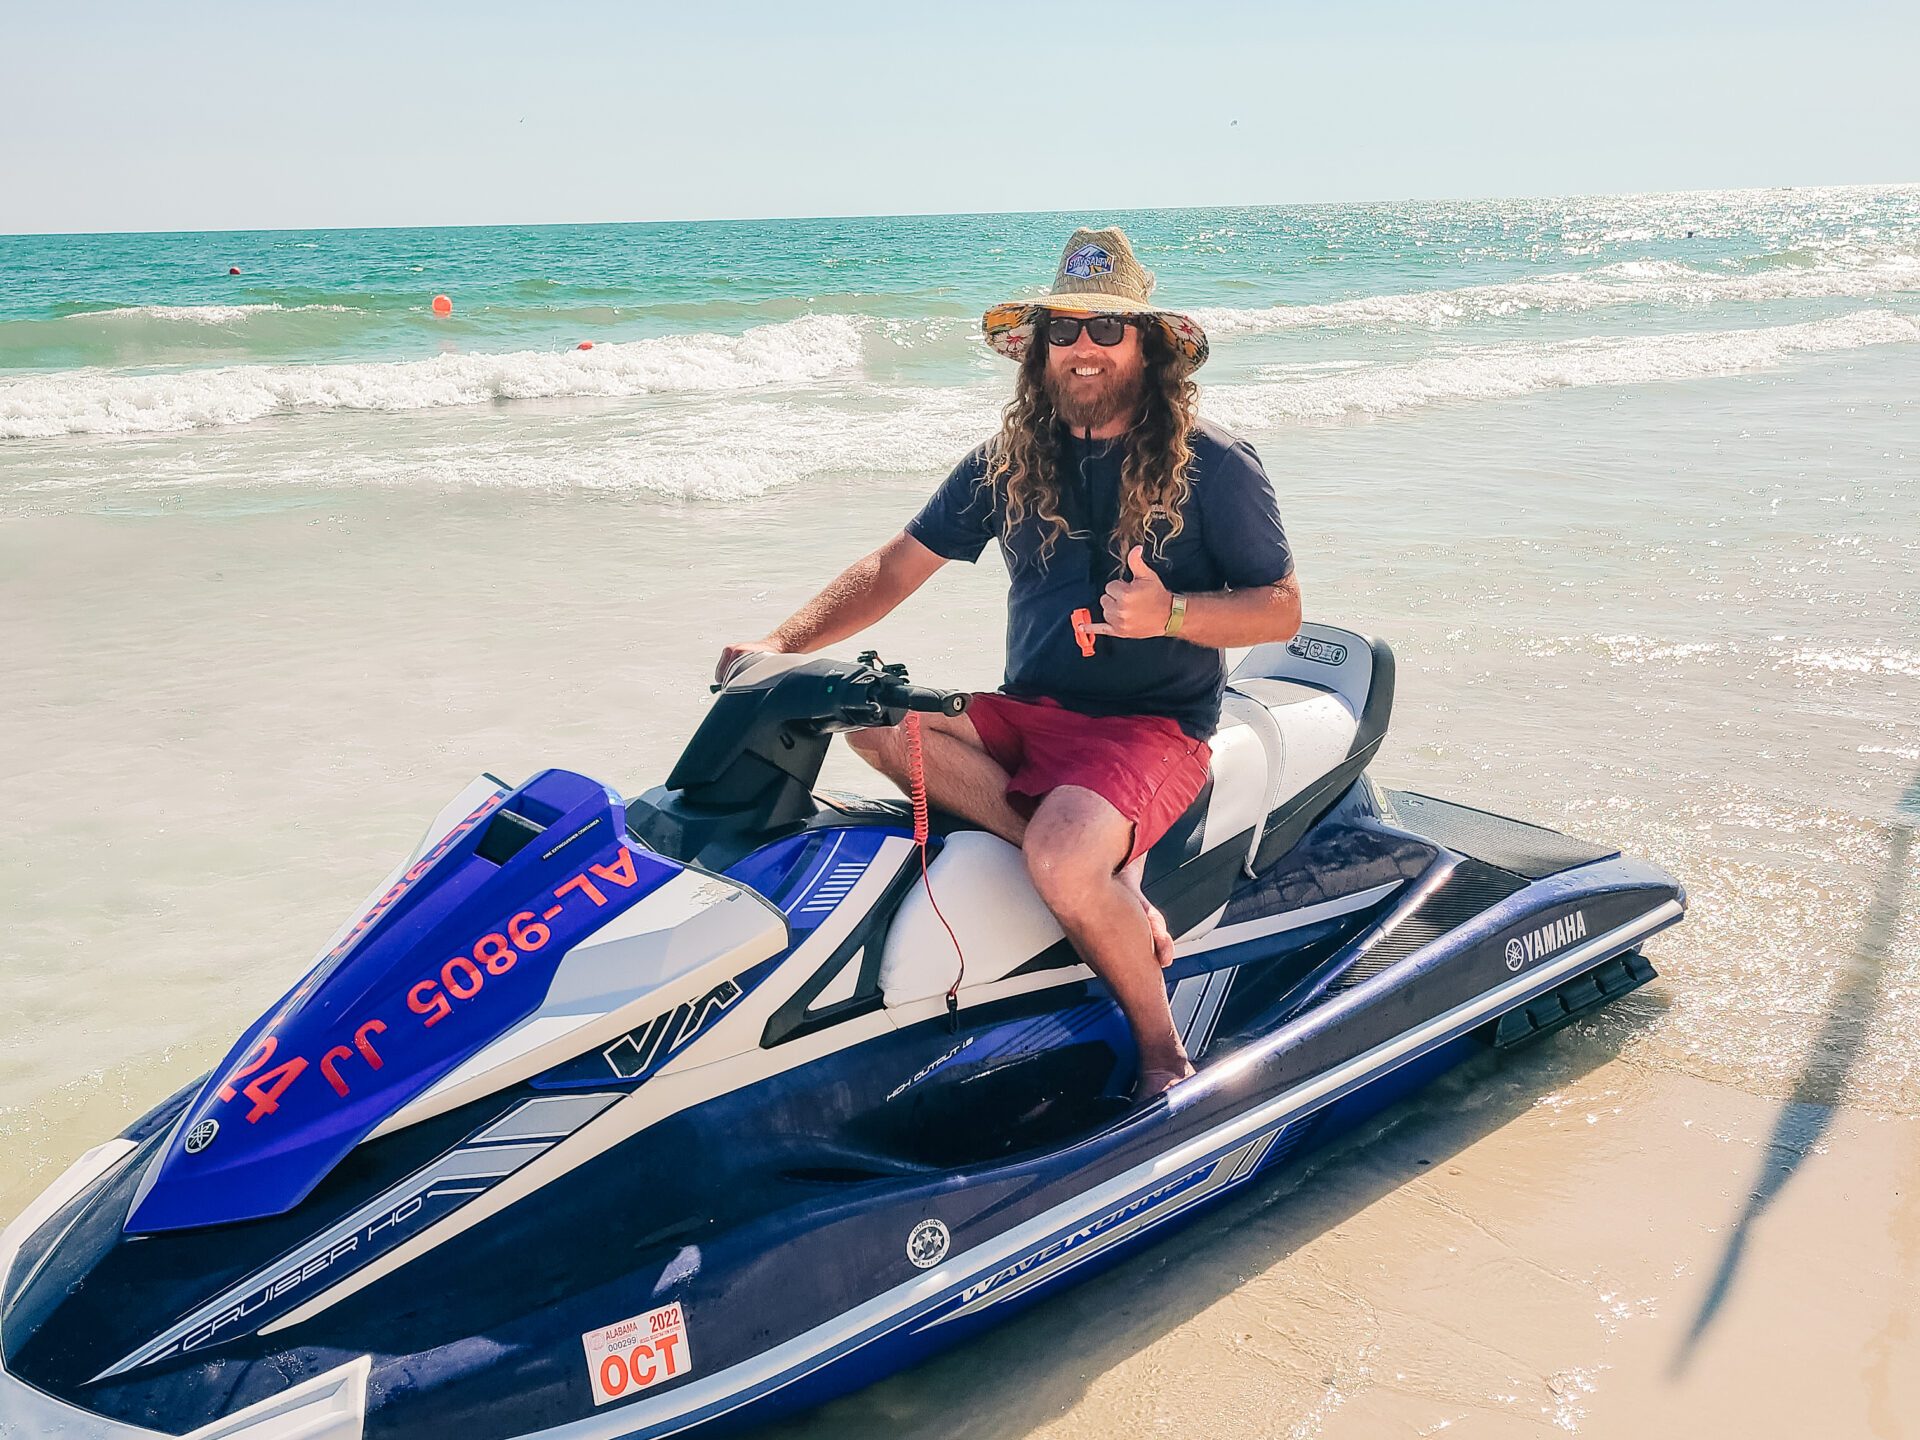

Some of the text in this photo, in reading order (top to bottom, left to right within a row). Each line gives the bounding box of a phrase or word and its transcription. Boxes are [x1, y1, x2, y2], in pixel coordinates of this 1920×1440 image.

[1069, 257, 1108, 269] STAY SALTY
[1522, 910, 1587, 962] YAMAHA
[320, 846, 639, 1099] AL-9805 JJ
[216, 1035, 310, 1125] 24
[913, 1045, 960, 1082] OUTPUT
[962, 1167, 1207, 1303] WAVERUNN
[183, 1197, 423, 1351] CRUISER HO
[605, 1322, 638, 1341] ALABAMA
[649, 1308, 680, 1333] 2022
[608, 1336, 637, 1353] 000299
[600, 1333, 679, 1396] OCT
